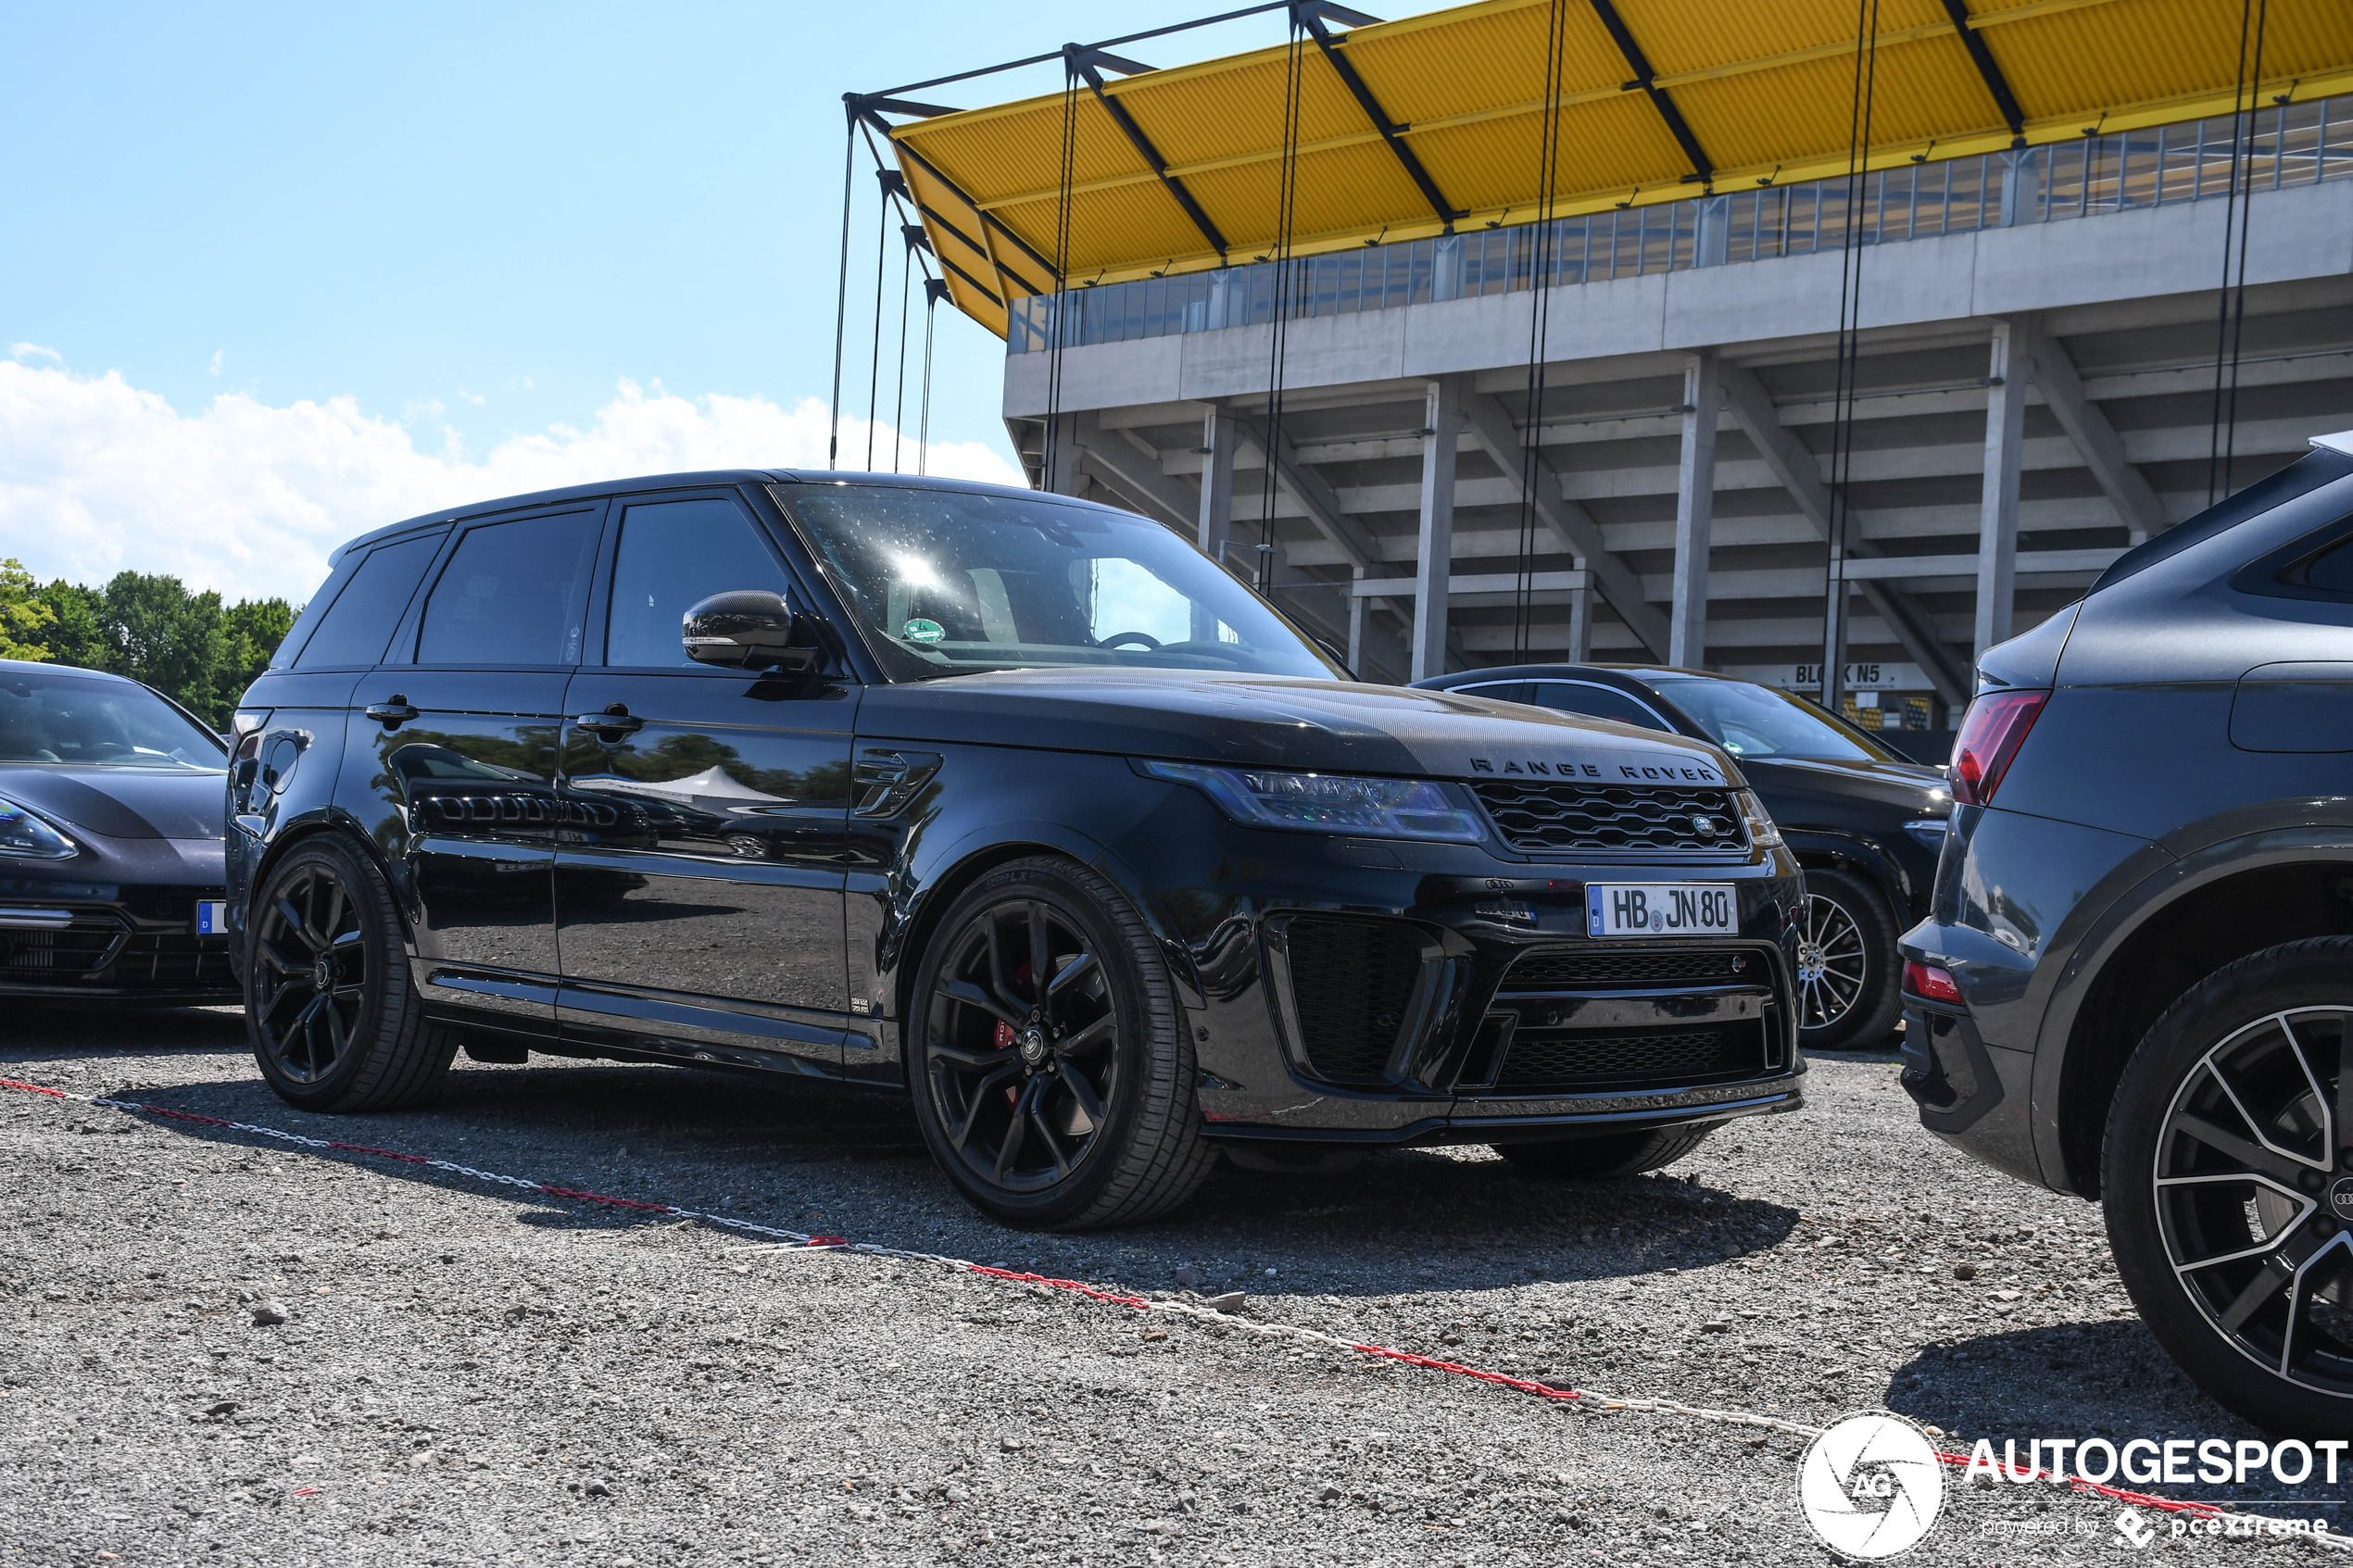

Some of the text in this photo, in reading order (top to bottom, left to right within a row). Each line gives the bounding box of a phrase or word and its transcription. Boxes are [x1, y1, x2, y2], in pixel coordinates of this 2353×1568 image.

[919, 622, 927, 631] 4
[1856, 664, 1880, 683] N5
[1470, 757, 1716, 781] RANGE ROVER
[1010, 872, 1027, 883] LX
[1613, 890, 1729, 928] HB JN 80
[1592, 916, 1600, 927] D
